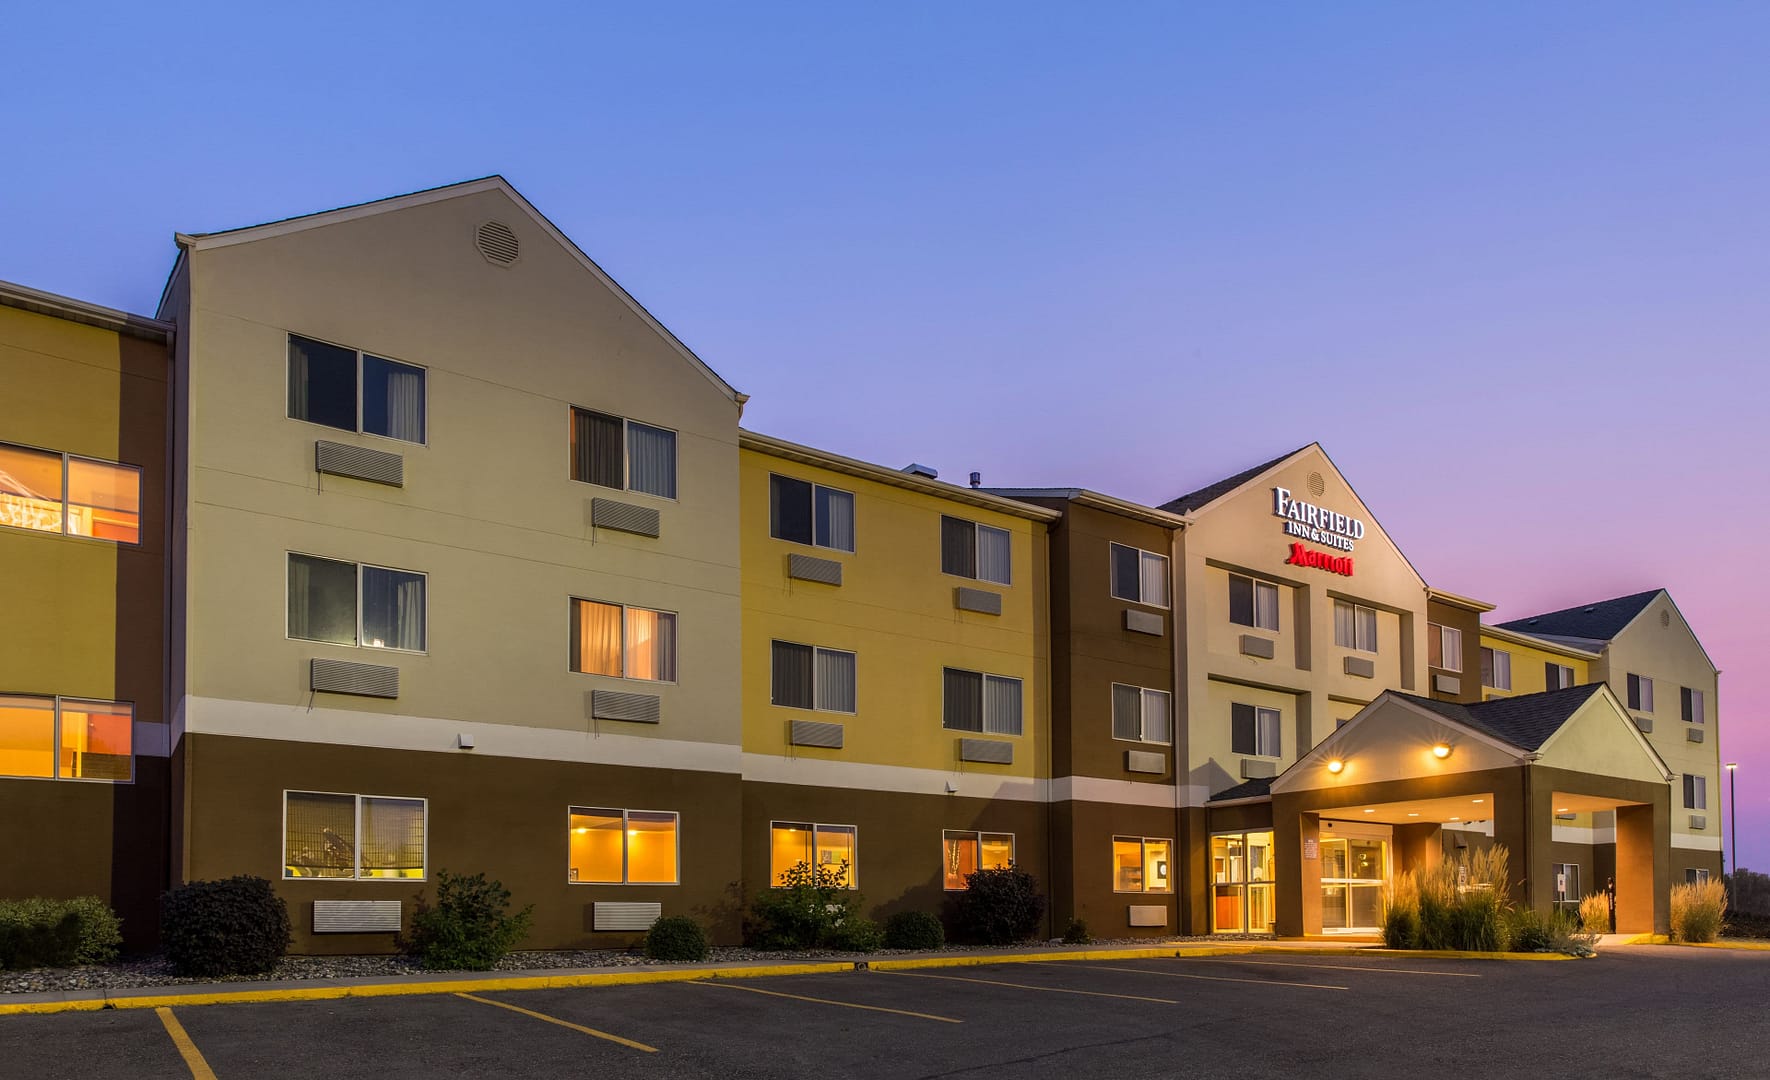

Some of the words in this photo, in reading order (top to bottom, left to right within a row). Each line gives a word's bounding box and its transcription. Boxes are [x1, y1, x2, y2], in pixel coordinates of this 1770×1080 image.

[1275, 486, 1364, 539] FAIRFIELD
[1286, 521, 1310, 539] INN
[1310, 527, 1320, 541] &
[1320, 530, 1354, 551] SUITES
[1288, 541, 1354, 576] Marriott
